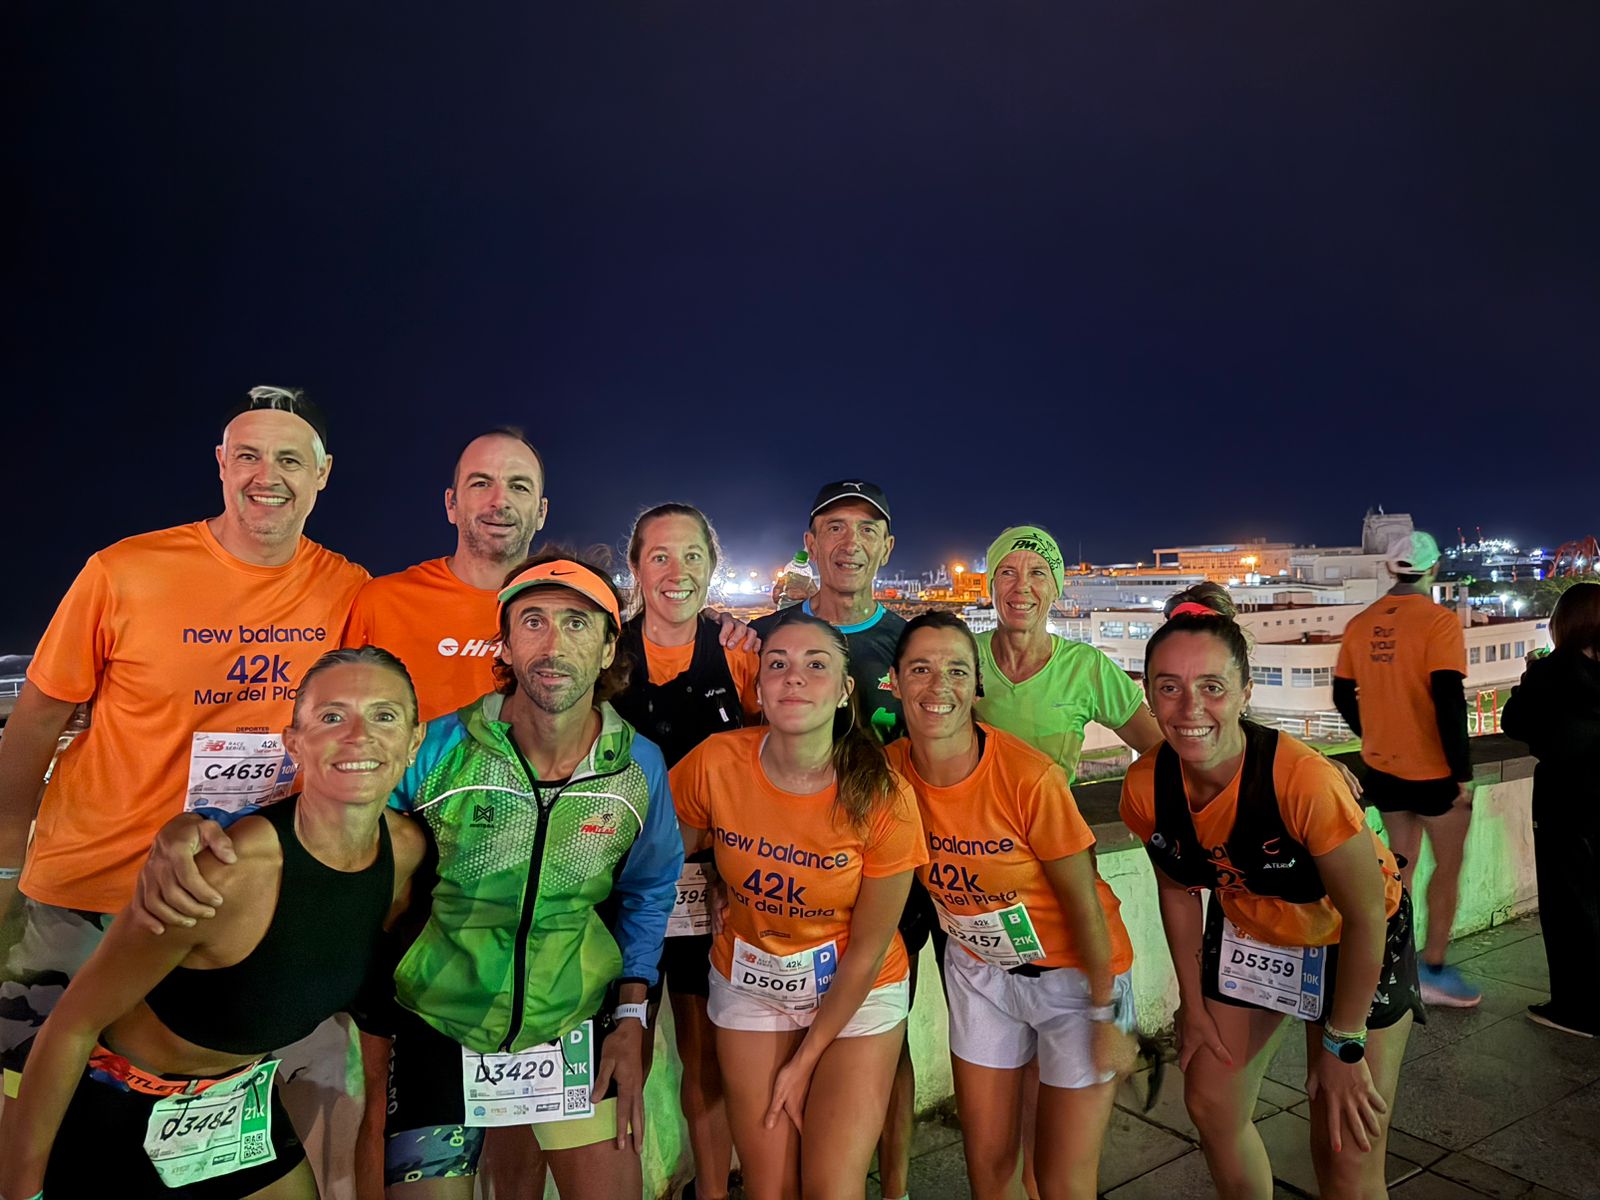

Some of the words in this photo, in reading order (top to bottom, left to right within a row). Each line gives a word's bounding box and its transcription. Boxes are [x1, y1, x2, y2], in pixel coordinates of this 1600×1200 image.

[182, 627, 233, 644] new
[239, 624, 327, 644] balance
[226, 654, 292, 685] 42k
[193, 689, 233, 706] Mar
[236, 686, 267, 702] del
[204, 762, 277, 780] C4636
[715, 826, 754, 852] new
[757, 836, 849, 871] balance
[929, 831, 1015, 856] balance
[743, 868, 807, 906] 42k
[928, 862, 985, 893] 42k
[943, 892, 970, 906] del
[973, 889, 1018, 906] Plata
[754, 899, 783, 916] del
[789, 906, 836, 919] Plata
[1008, 913, 1021, 925] B
[1013, 934, 1034, 946] 21K
[820, 951, 831, 964] D
[1230, 949, 1295, 978] D5359
[742, 971, 807, 993] D5061
[1302, 972, 1319, 986] 10K
[570, 1029, 583, 1044] D
[474, 1059, 555, 1083] D3420
[565, 1061, 588, 1076] 21K
[244, 1105, 265, 1121] 21K
[159, 1105, 238, 1142] D3482
